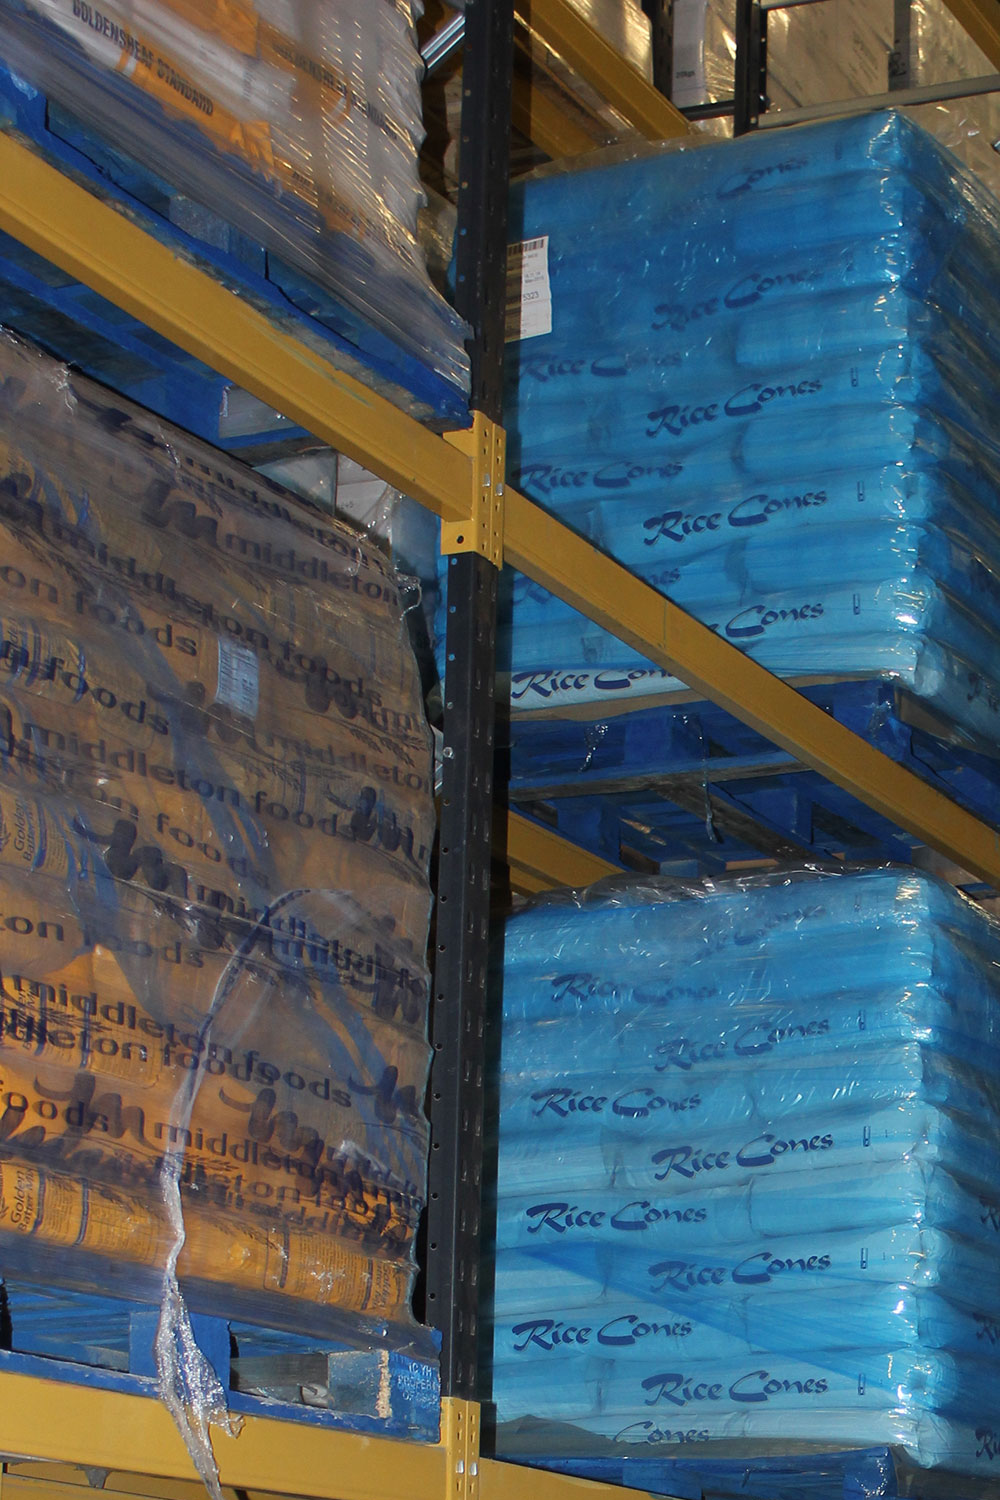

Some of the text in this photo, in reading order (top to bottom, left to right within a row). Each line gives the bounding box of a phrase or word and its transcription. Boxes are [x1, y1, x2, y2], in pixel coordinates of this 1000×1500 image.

[156, 57, 214, 116] STANDARD
[646, 377, 822, 438] Rice Cones
[516, 461, 683, 494] Rice Cones
[643, 490, 829, 546] Rice Cones
[225, 532, 401, 606] middleton
[72, 587, 198, 657] foods
[725, 602, 824, 638] Cones
[48, 657, 169, 736] foods
[511, 670, 589, 699] Rice
[24, 719, 241, 808] middleton
[157, 811, 270, 890] foods
[12, 974, 233, 1064] middleton
[654, 1018, 830, 1071] Rice Cones
[532, 1088, 702, 1118] Rice Cones
[652, 1133, 834, 1181] Rice Cones
[11, 1169, 26, 1223] Golden
[18, 1195, 34, 1231] Batter
[526, 1200, 708, 1233] Rice Cones
[648, 1252, 832, 1292] Rice Cones
[512, 1315, 694, 1350] Rice Cones
[641, 1370, 829, 1407] Rice Cones
[614, 1420, 710, 1445] Cones
